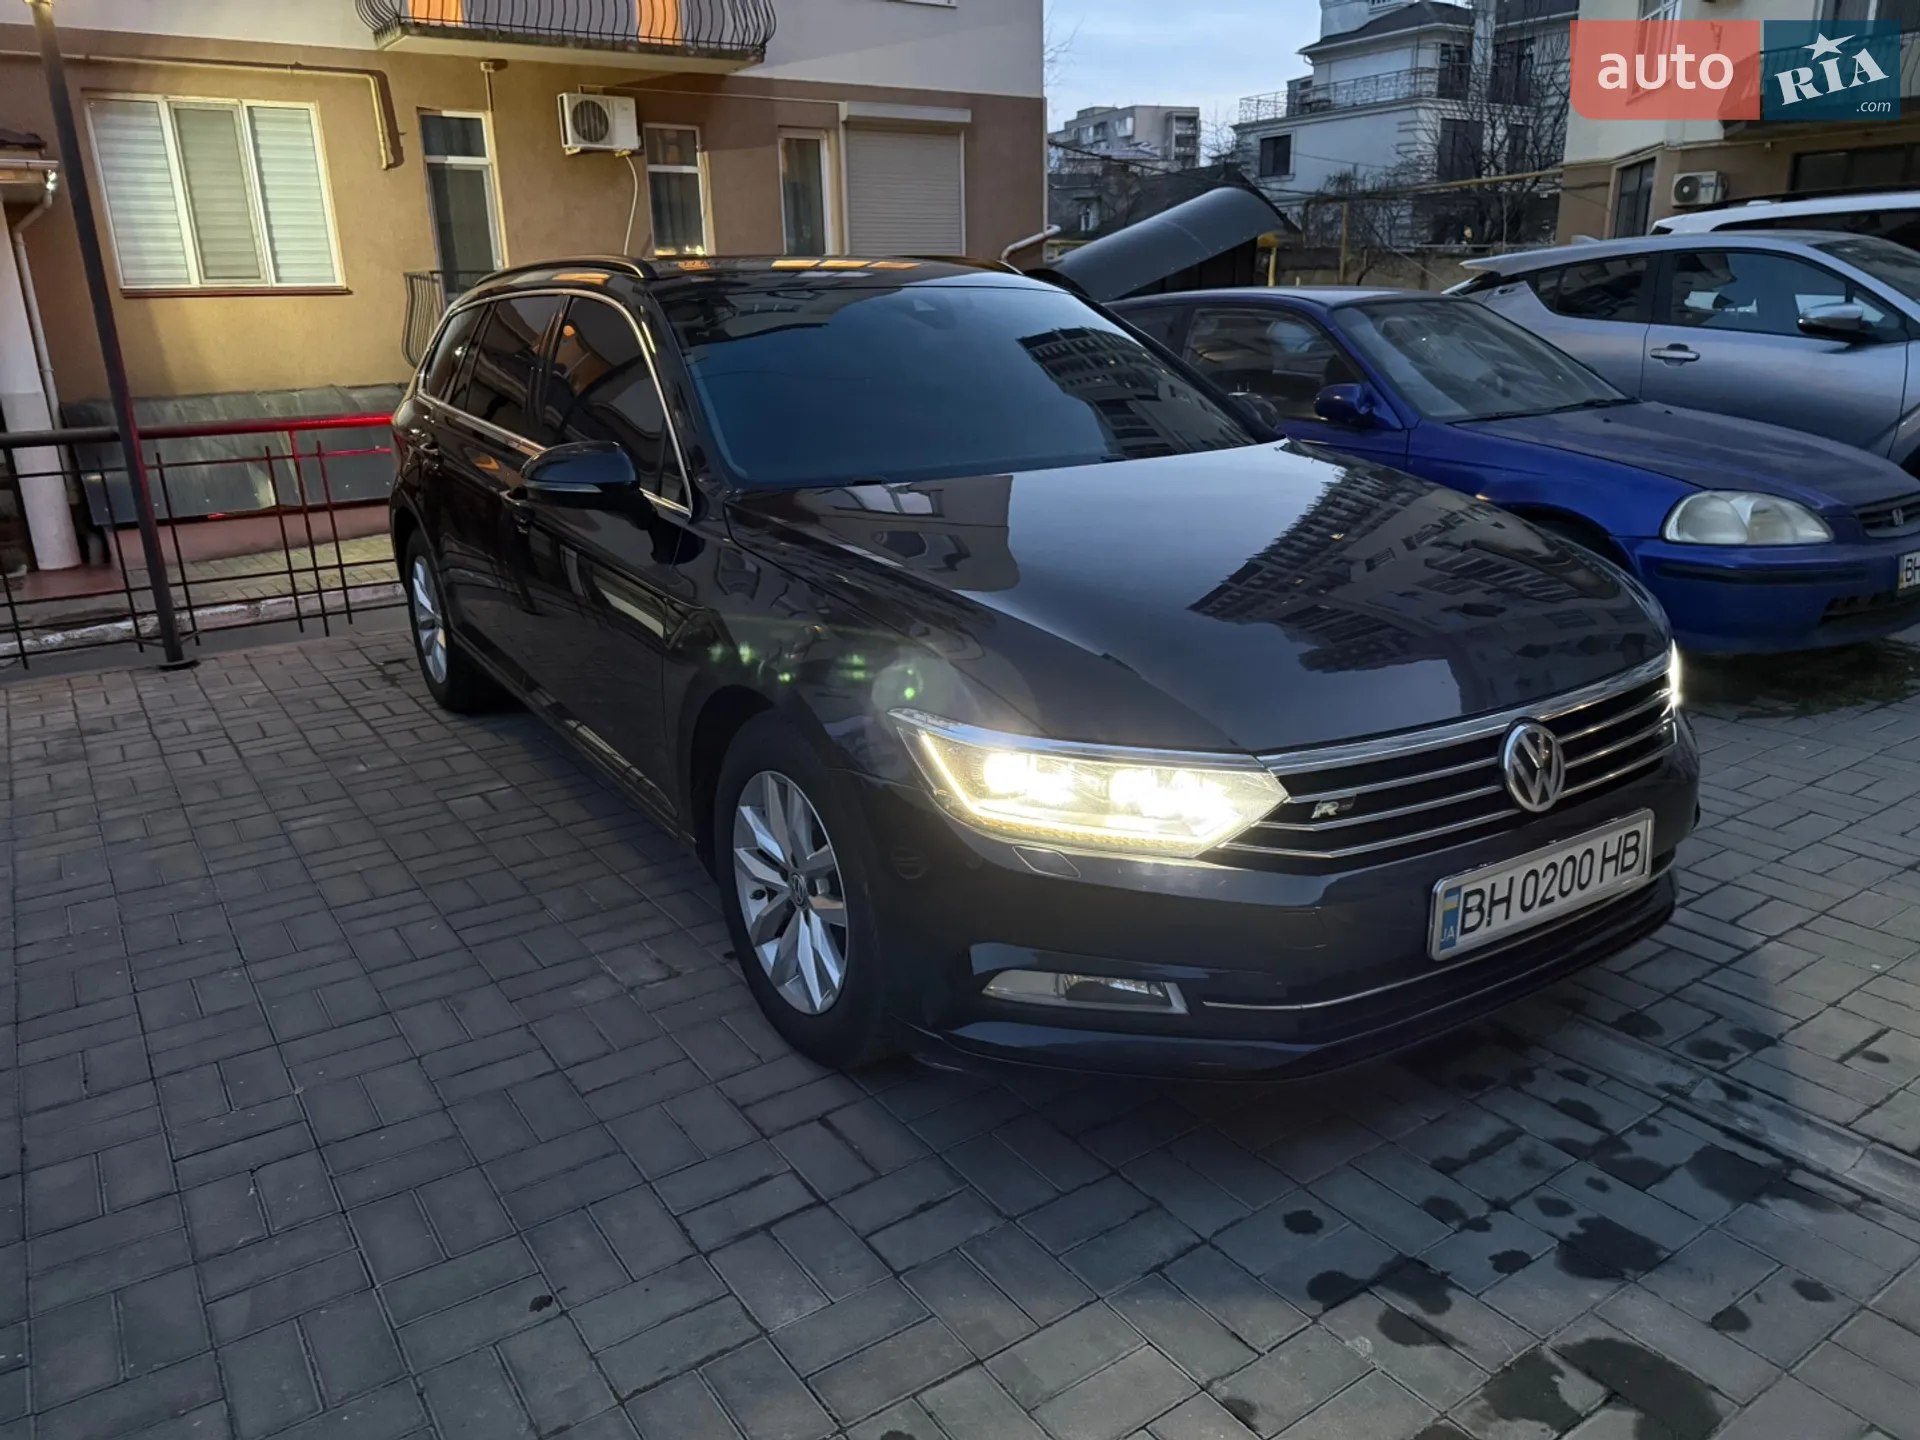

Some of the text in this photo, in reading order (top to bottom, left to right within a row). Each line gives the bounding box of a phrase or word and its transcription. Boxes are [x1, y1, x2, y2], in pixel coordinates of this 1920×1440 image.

[1460, 829, 1641, 936] BH 0200 HB
